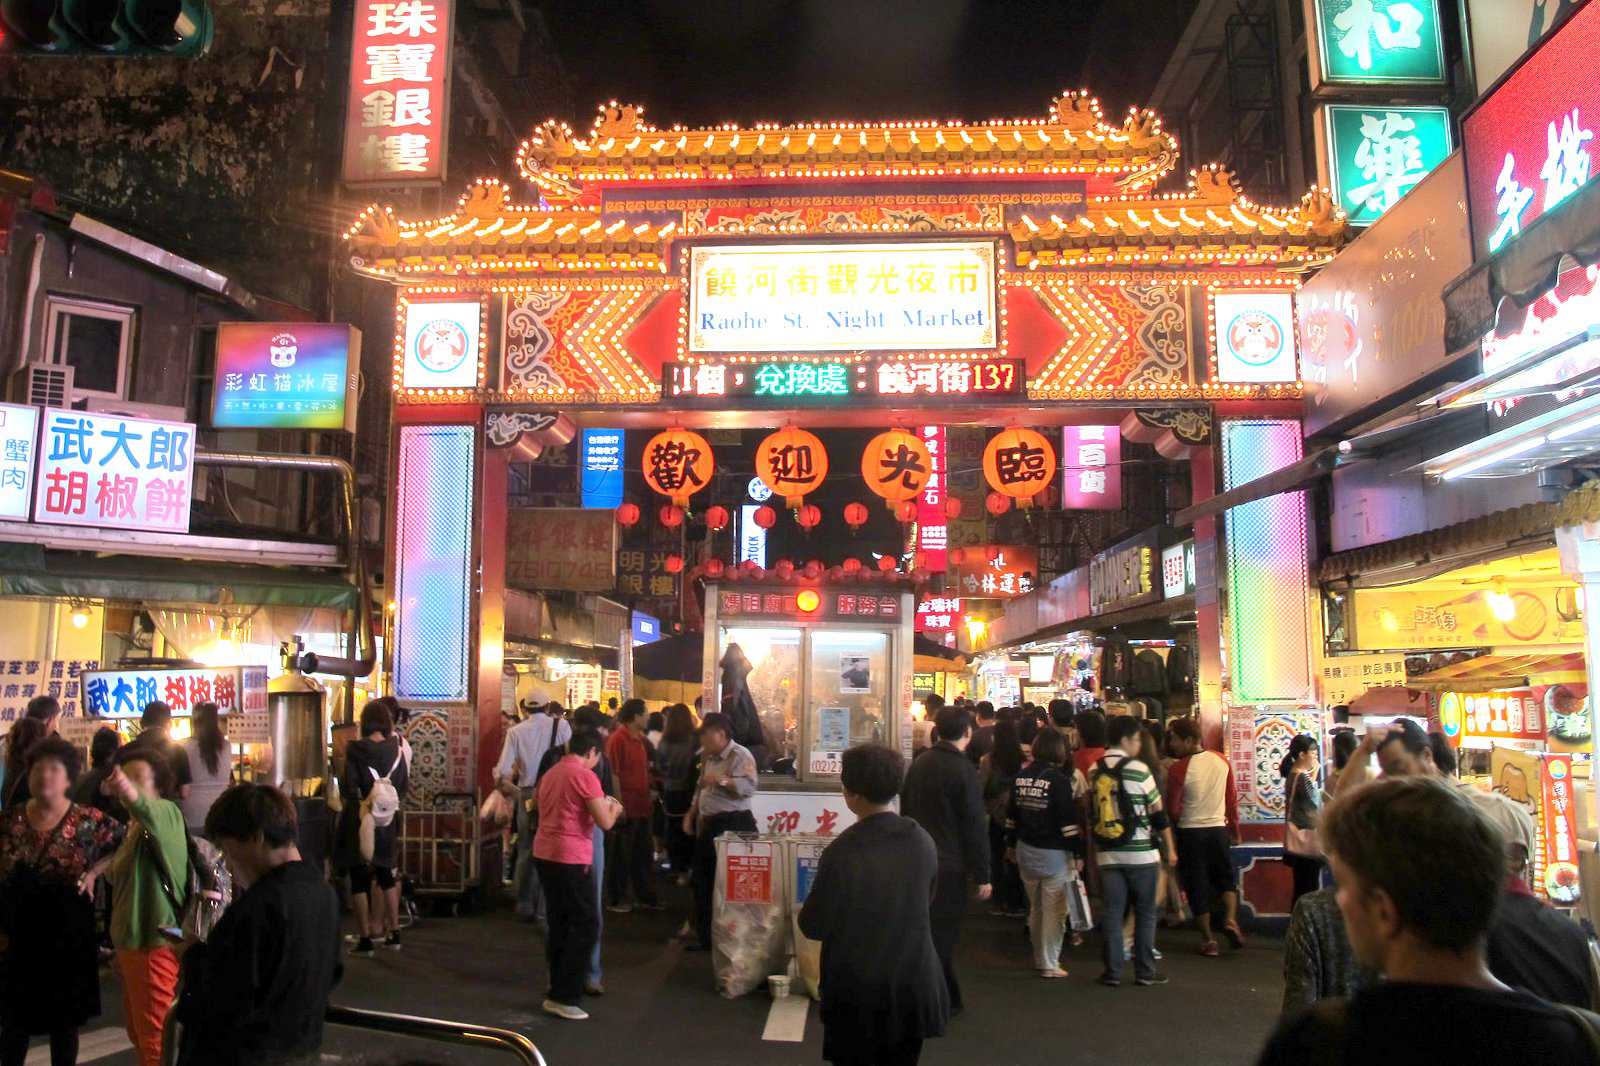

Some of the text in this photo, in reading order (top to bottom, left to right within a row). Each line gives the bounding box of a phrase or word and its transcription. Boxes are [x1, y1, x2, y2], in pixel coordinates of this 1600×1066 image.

[359, 0, 438, 173] 珠寶銀樓
[705, 262, 980, 298] 饒河街觀光夜市
[700, 308, 985, 330] Raohe St. Night Market
[48, 415, 189, 473] 武大郎
[45, 466, 188, 523] 胡椒餅
